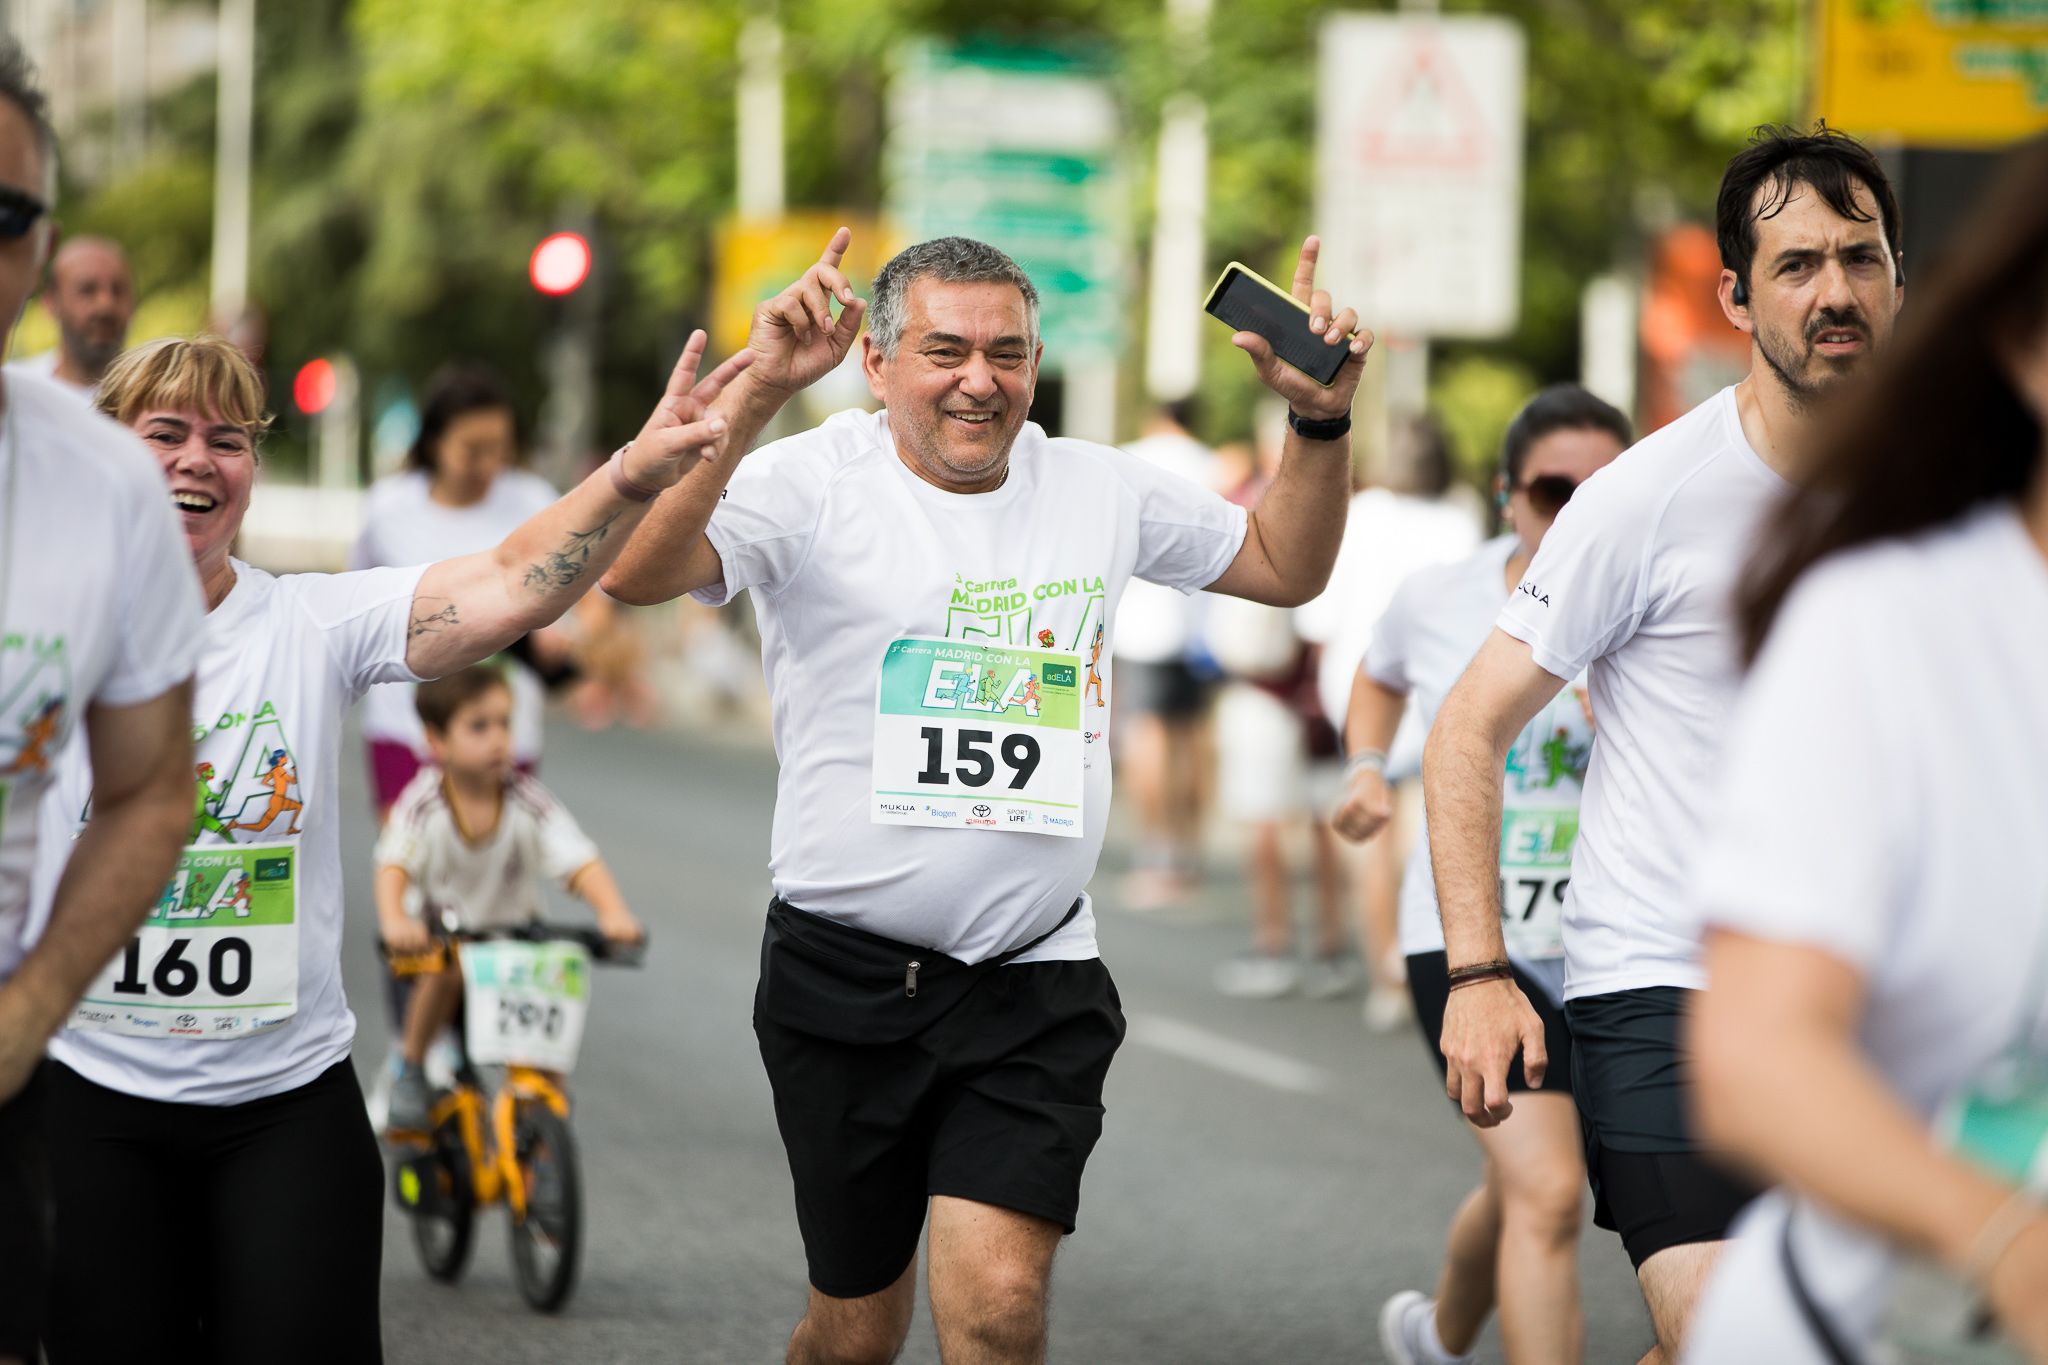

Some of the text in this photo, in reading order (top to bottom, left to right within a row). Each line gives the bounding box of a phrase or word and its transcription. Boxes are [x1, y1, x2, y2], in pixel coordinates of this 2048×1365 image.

[951, 576, 1104, 614] MDRID CON LA
[901, 646, 932, 655] Carrera
[934, 647, 983, 662] MADRID
[986, 653, 1013, 664] CON
[1015, 657, 1031, 666] LA
[1047, 673, 1072, 683] adELA
[921, 659, 1040, 718] ELA
[917, 726, 1041, 790] 159
[880, 803, 915, 812] MUKUA
[931, 808, 957, 818] Biogen
[1009, 815, 1026, 823] LIFE
[1049, 818, 1074, 827] MADRID
[193, 856, 225, 868] CON
[225, 855, 244, 867] LA
[148, 867, 251, 919] LA
[114, 936, 252, 998] 160
